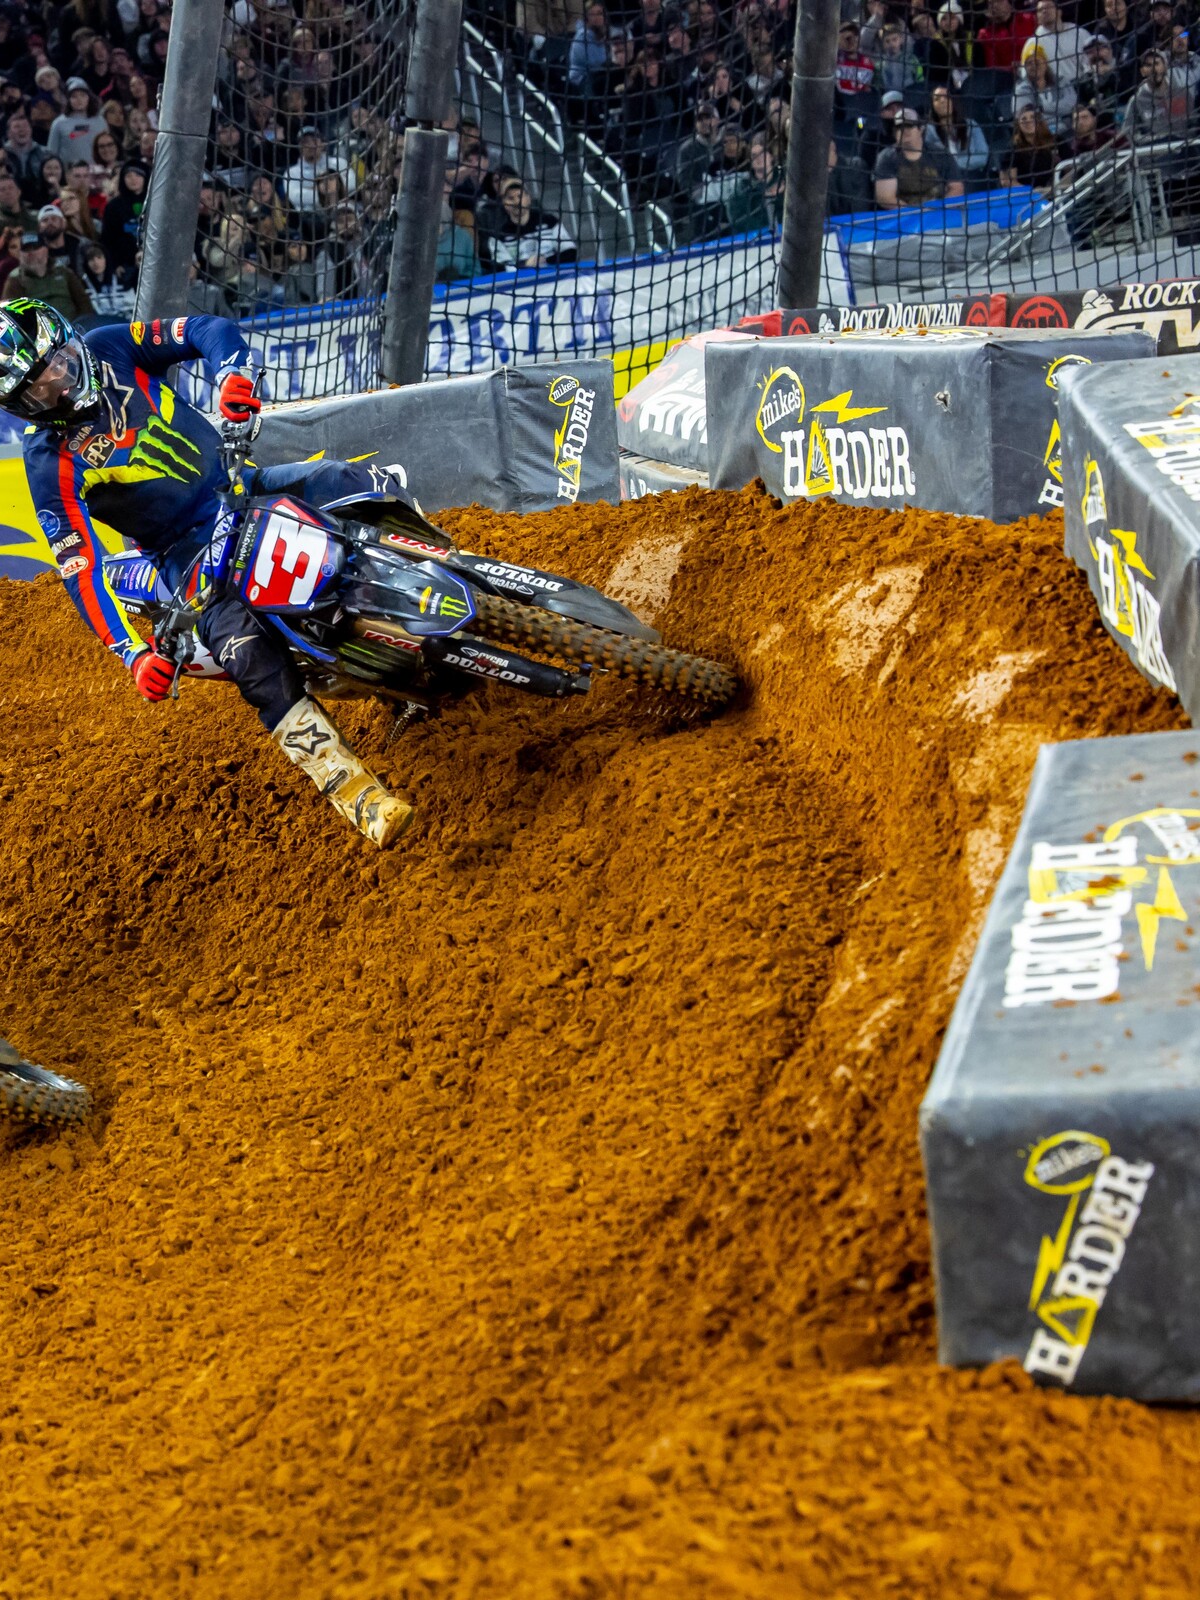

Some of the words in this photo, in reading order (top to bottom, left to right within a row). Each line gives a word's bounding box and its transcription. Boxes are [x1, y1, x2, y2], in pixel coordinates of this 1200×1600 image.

[884, 302, 964, 329] MOUNTAIN
[1119, 282, 1200, 311] ROCK
[551, 380, 577, 401] mike's
[762, 384, 801, 431] mike's
[556, 387, 596, 503] HARDER
[780, 420, 917, 499] HARDER
[254, 504, 328, 605] 3
[474, 562, 564, 592] DUNLOP
[442, 653, 531, 686] DUNLOP
[1023, 1154, 1155, 1386] HARDER
